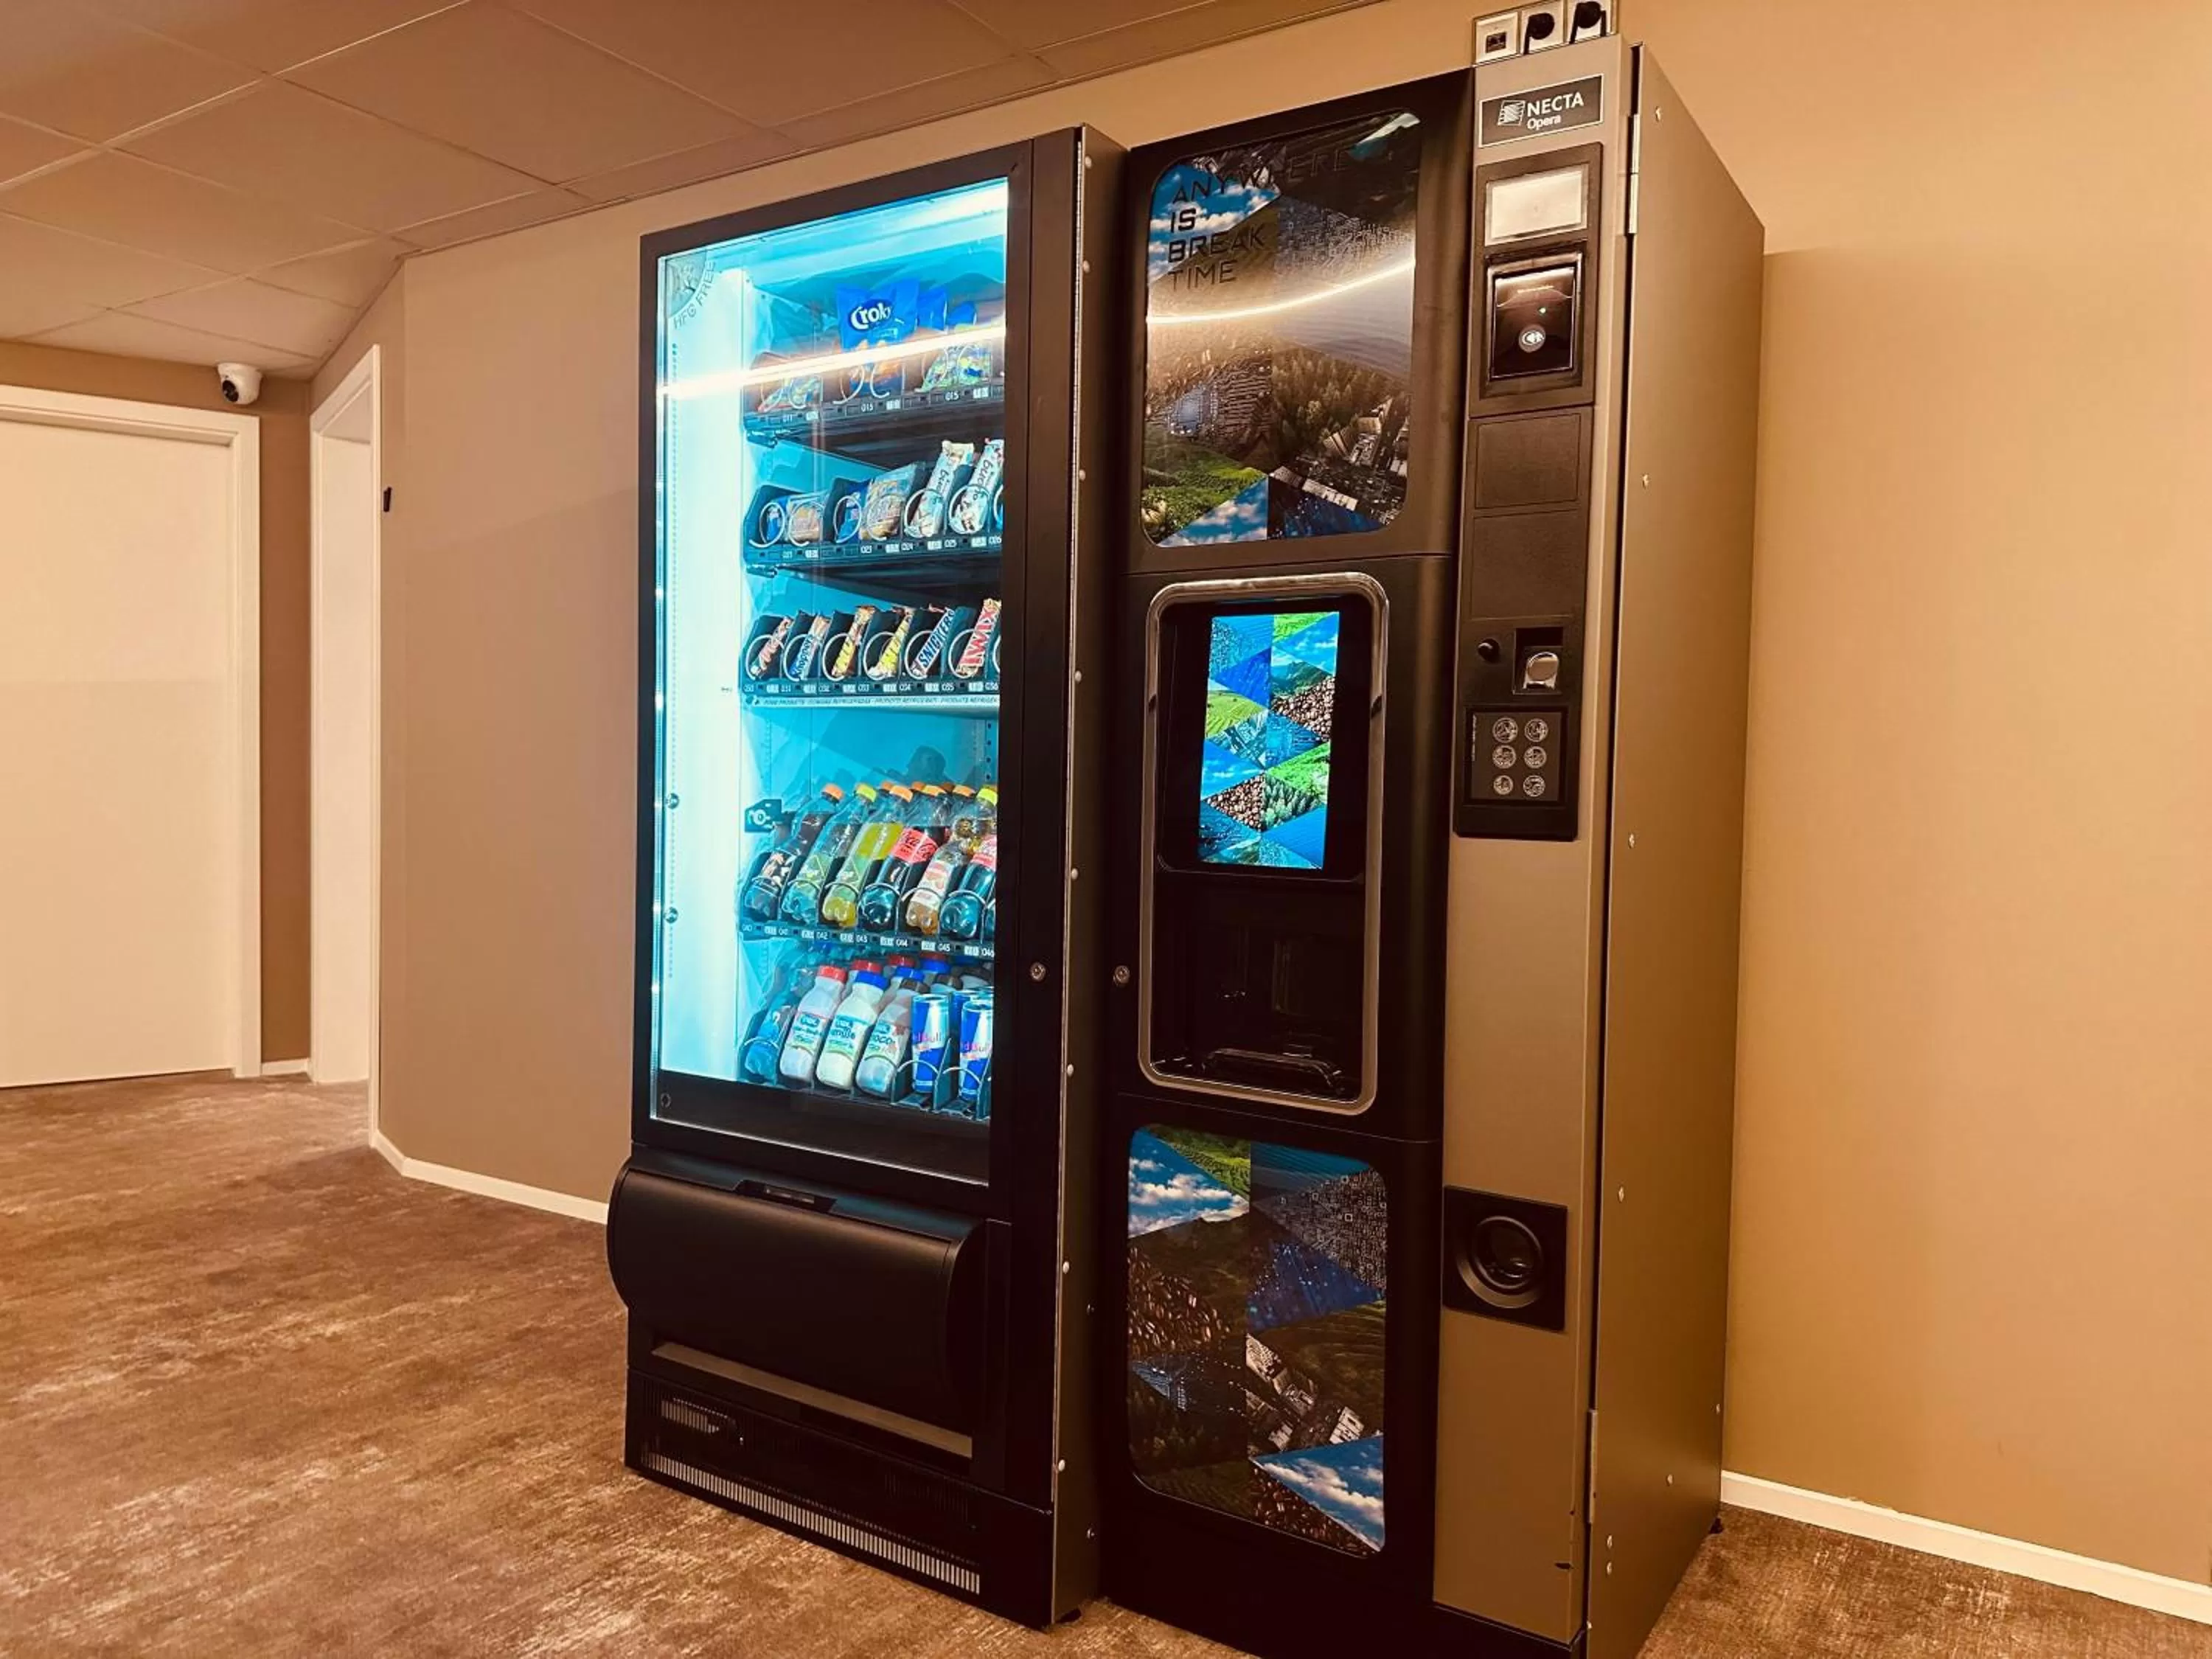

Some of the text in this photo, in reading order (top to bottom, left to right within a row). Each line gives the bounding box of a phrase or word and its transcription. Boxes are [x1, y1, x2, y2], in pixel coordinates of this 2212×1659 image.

[1527, 91, 1584, 117] NECTA
[1527, 115, 1561, 131] Opera
[1170, 208, 1196, 233] IS
[1168, 224, 1265, 262] BREAK
[695, 261, 714, 307] FREE
[1167, 260, 1238, 291] TIME
